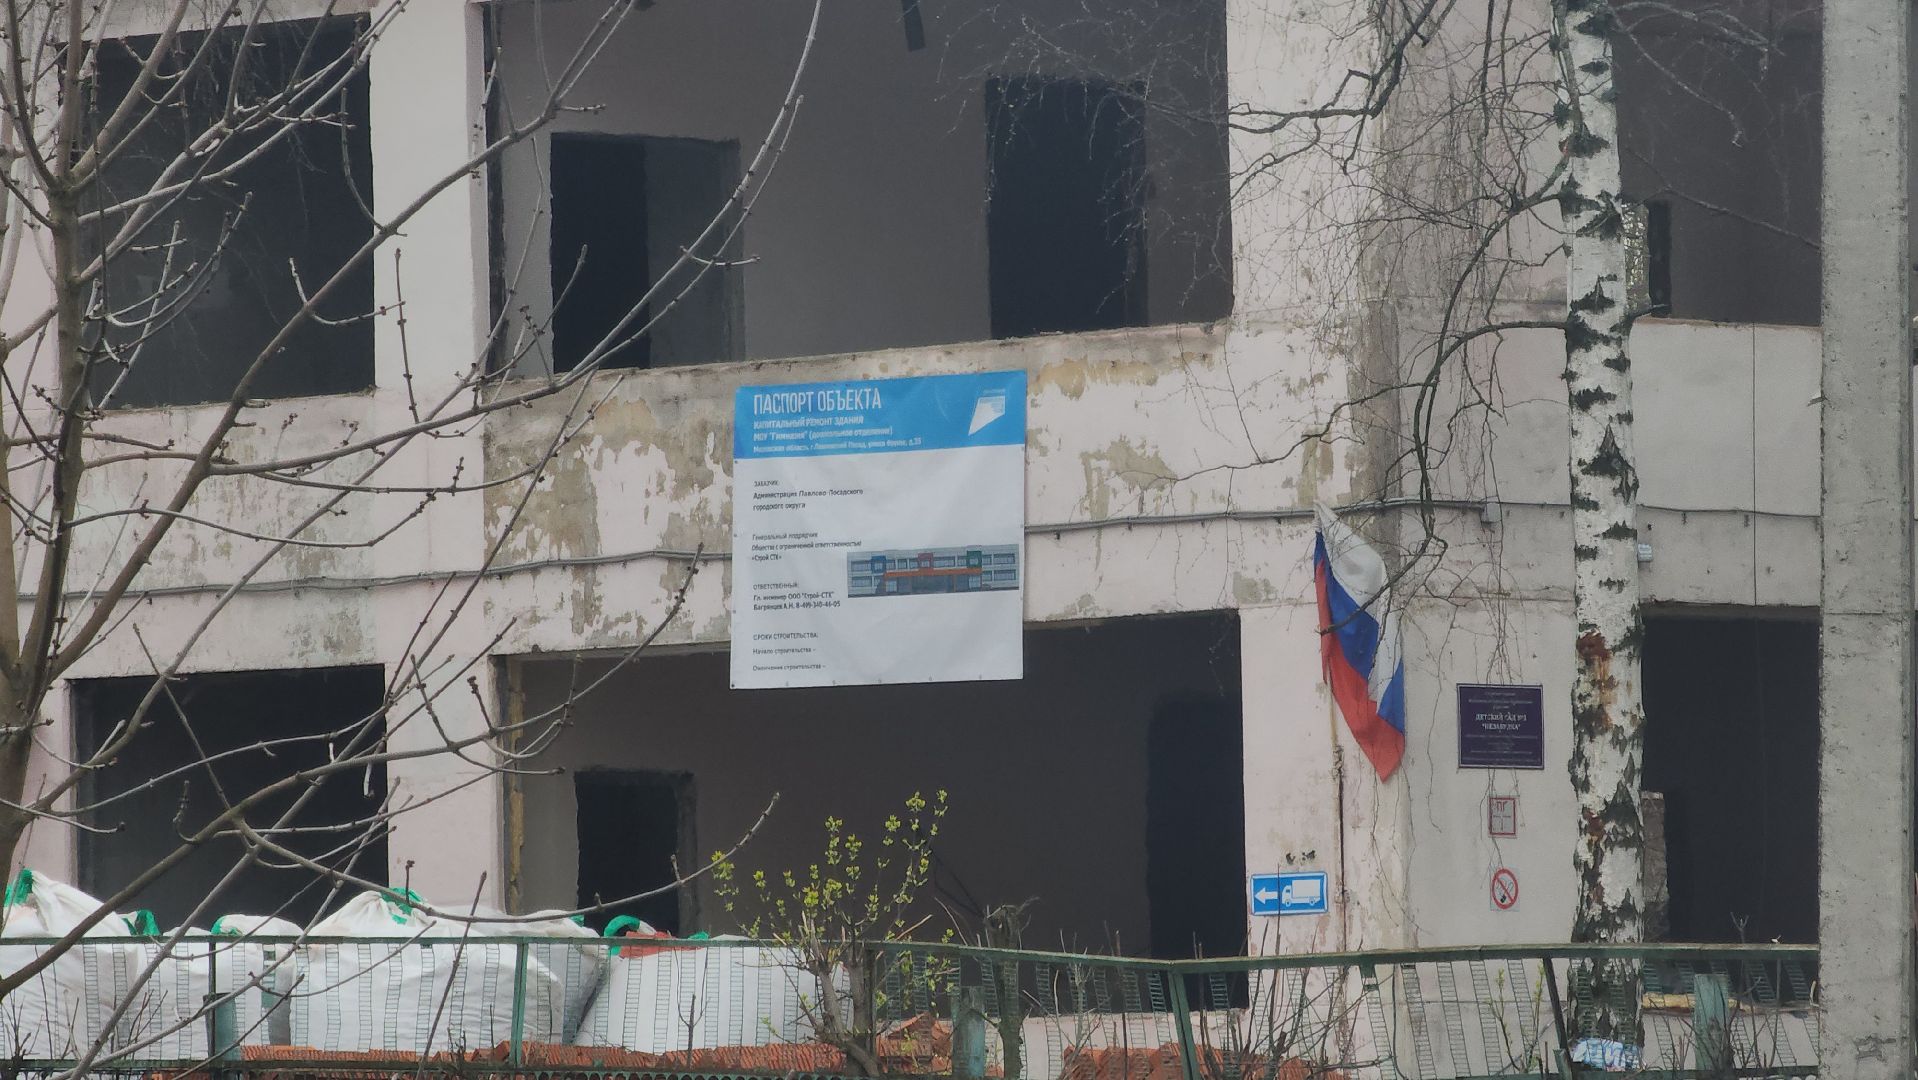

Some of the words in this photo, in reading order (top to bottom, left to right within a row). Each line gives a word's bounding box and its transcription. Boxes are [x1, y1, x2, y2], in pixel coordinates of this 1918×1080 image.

[754, 391, 814, 415] ПАСПОРТ
[817, 387, 882, 412] ОБЪЕКТА
[754, 417, 805, 430] КАПИТАЛЬНЫЙ
[806, 417, 833, 427] РЕМОНТ
[834, 415, 865, 426] ЗДАНИЯ
[754, 432, 768, 442] МОУ
[753, 491, 797, 500] Администрация
[753, 503, 784, 512] городского
[785, 502, 806, 511] округа
[753, 633, 773, 641] СРОКИ
[774, 647, 812, 655] строительства
[1475, 712, 1504, 721] ДЕТСКИЙ
